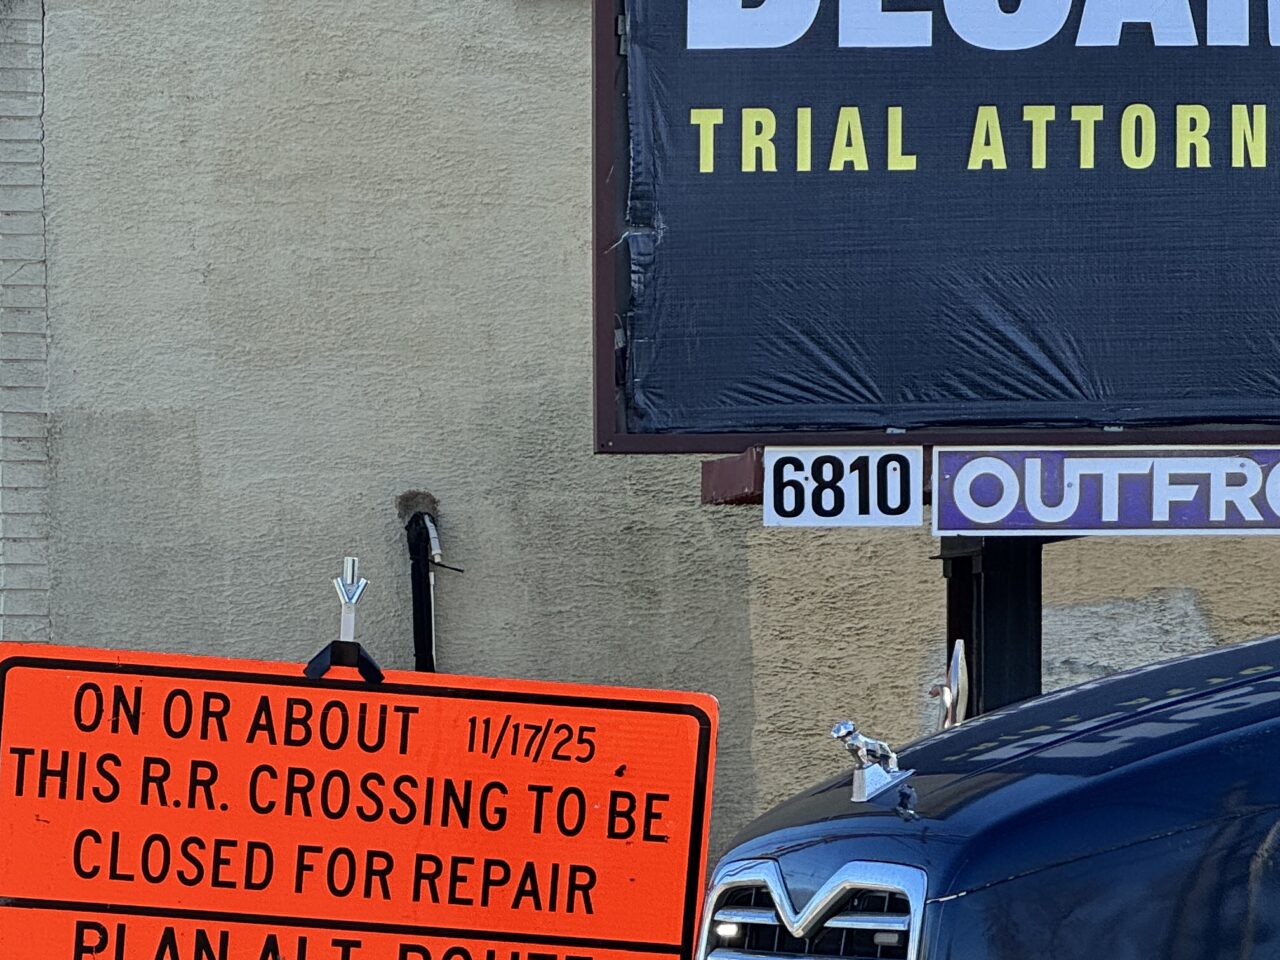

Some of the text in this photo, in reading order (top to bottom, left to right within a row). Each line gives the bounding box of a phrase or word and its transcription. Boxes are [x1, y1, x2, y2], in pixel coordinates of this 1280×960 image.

[690, 103, 1267, 173] TRIAL ATTORN
[773, 453, 911, 518] 6810
[953, 456, 1280, 524] OUTFR
[74, 682, 596, 764] ON OR ABOUT 11/17/25
[10, 747, 670, 843] THIS R.R. CROSSING TO BE
[74, 828, 597, 915] CLOSED FOR REPAIR
